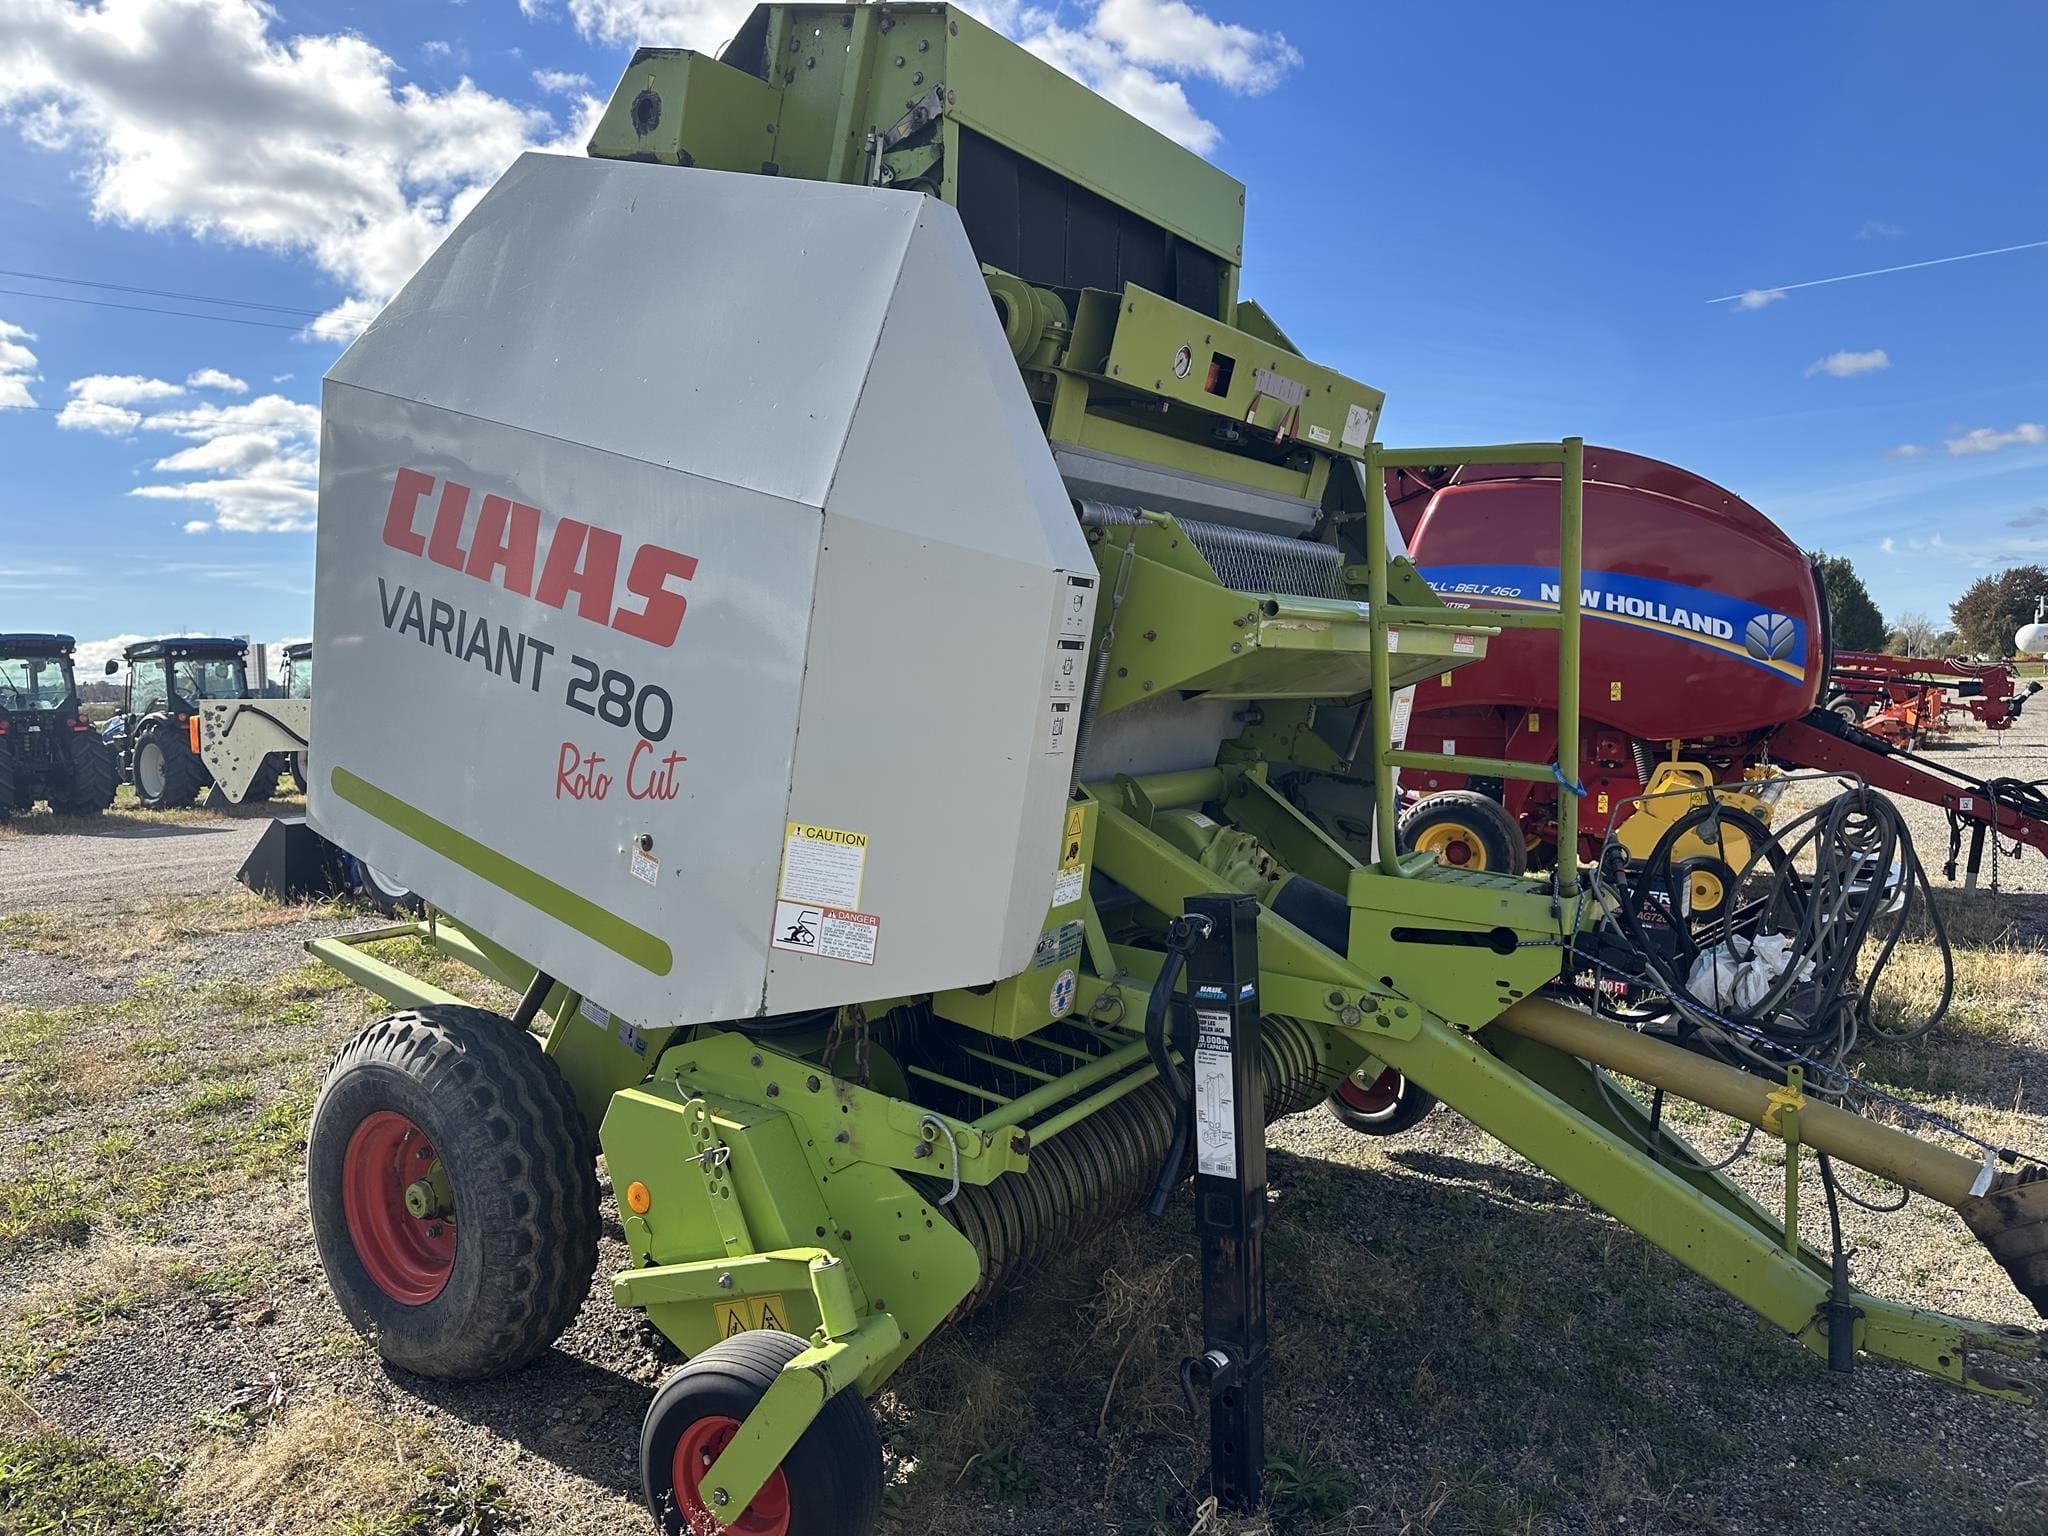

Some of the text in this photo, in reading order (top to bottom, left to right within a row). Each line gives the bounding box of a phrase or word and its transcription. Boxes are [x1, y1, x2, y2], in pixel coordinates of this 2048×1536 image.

[382, 467, 699, 648] CLAAS
[1491, 586, 1521, 597] 460
[1540, 583, 1733, 640] NW HOLLAND
[377, 576, 674, 742] VARIANT 280
[555, 739, 687, 801] Roto Cut
[806, 827, 866, 846] CAUTION
[838, 911, 876, 925] DANGER
[1615, 982, 1625, 993] FT
[1207, 1044, 1229, 1052] CAPACITY
